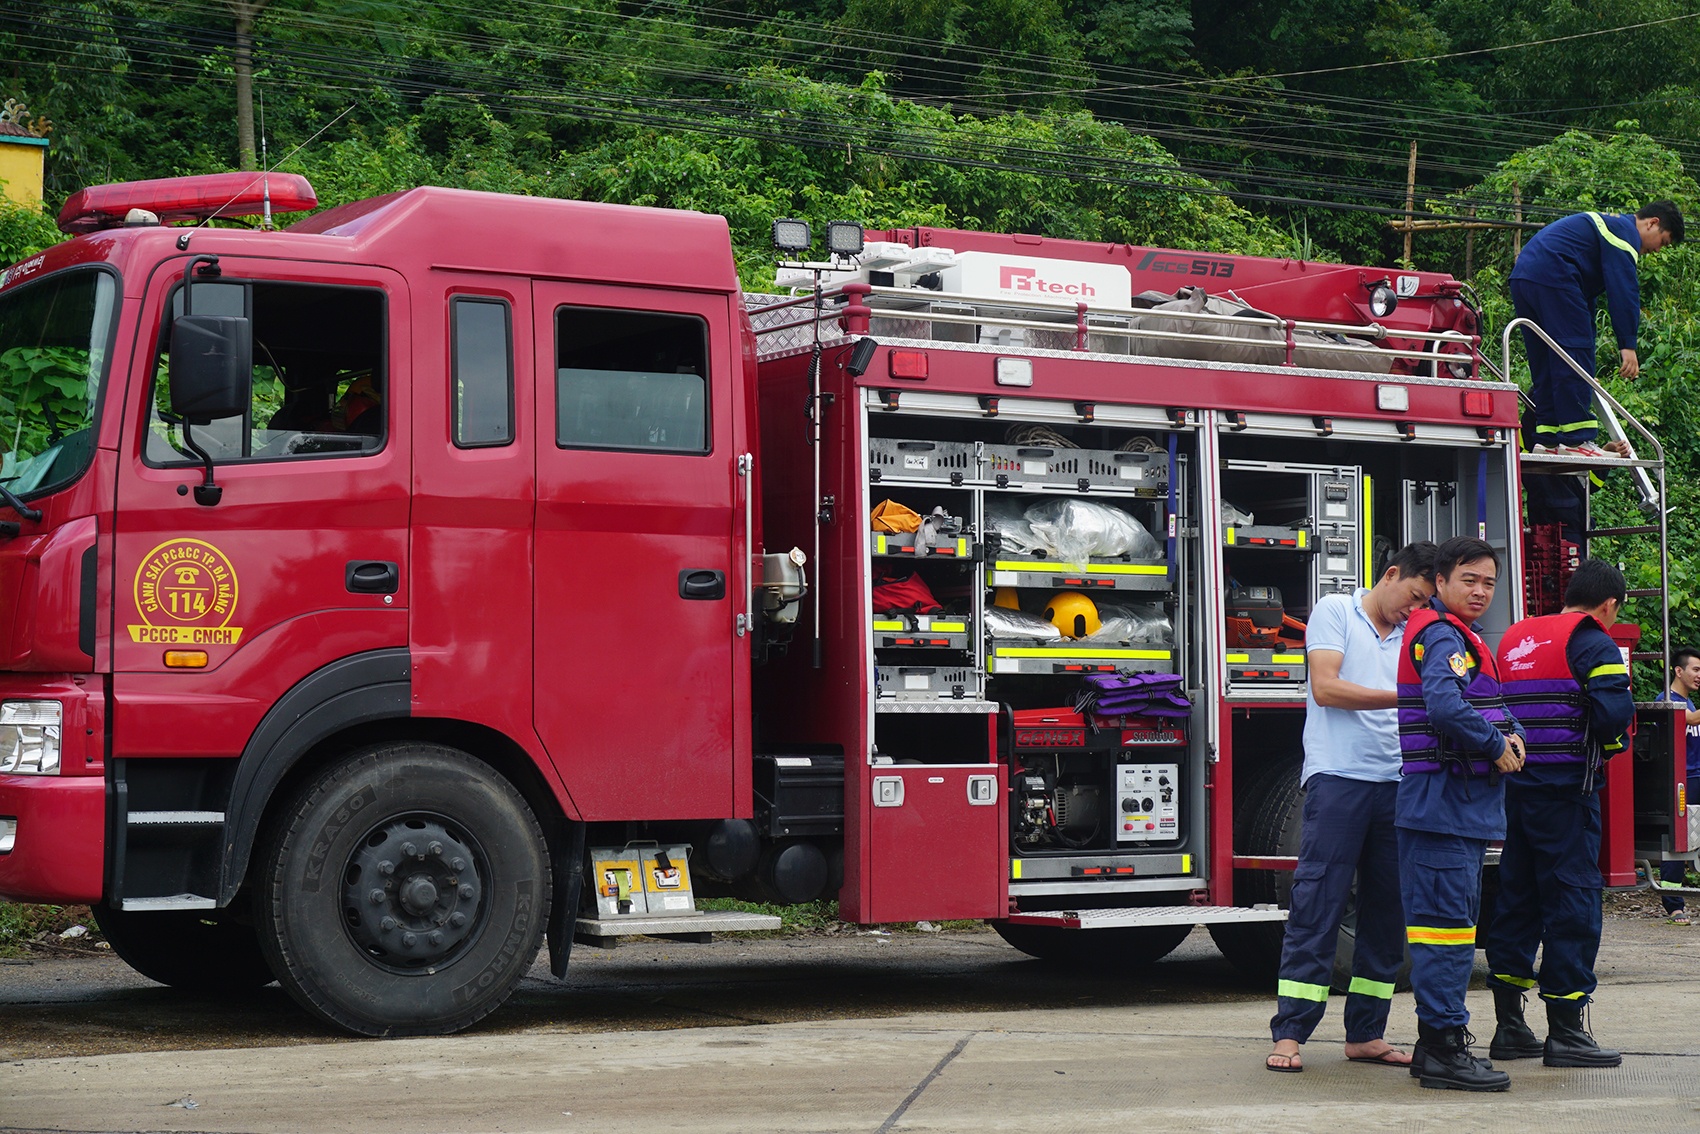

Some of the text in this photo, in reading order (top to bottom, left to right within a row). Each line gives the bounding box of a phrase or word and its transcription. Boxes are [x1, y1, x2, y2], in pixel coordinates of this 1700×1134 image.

[1152, 259, 1235, 278] SCS 513
[145, 559, 163, 579] SÁT
[162, 547, 200, 563] PC&CC
[202, 552, 215, 568] TP.
[169, 592, 205, 613] 114
[139, 628, 178, 642] PCCC
[193, 629, 232, 644] CNCH
[1017, 731, 1082, 746] GENEX
[306, 796, 365, 880] KRA50
[478, 894, 533, 988] KUMHO
